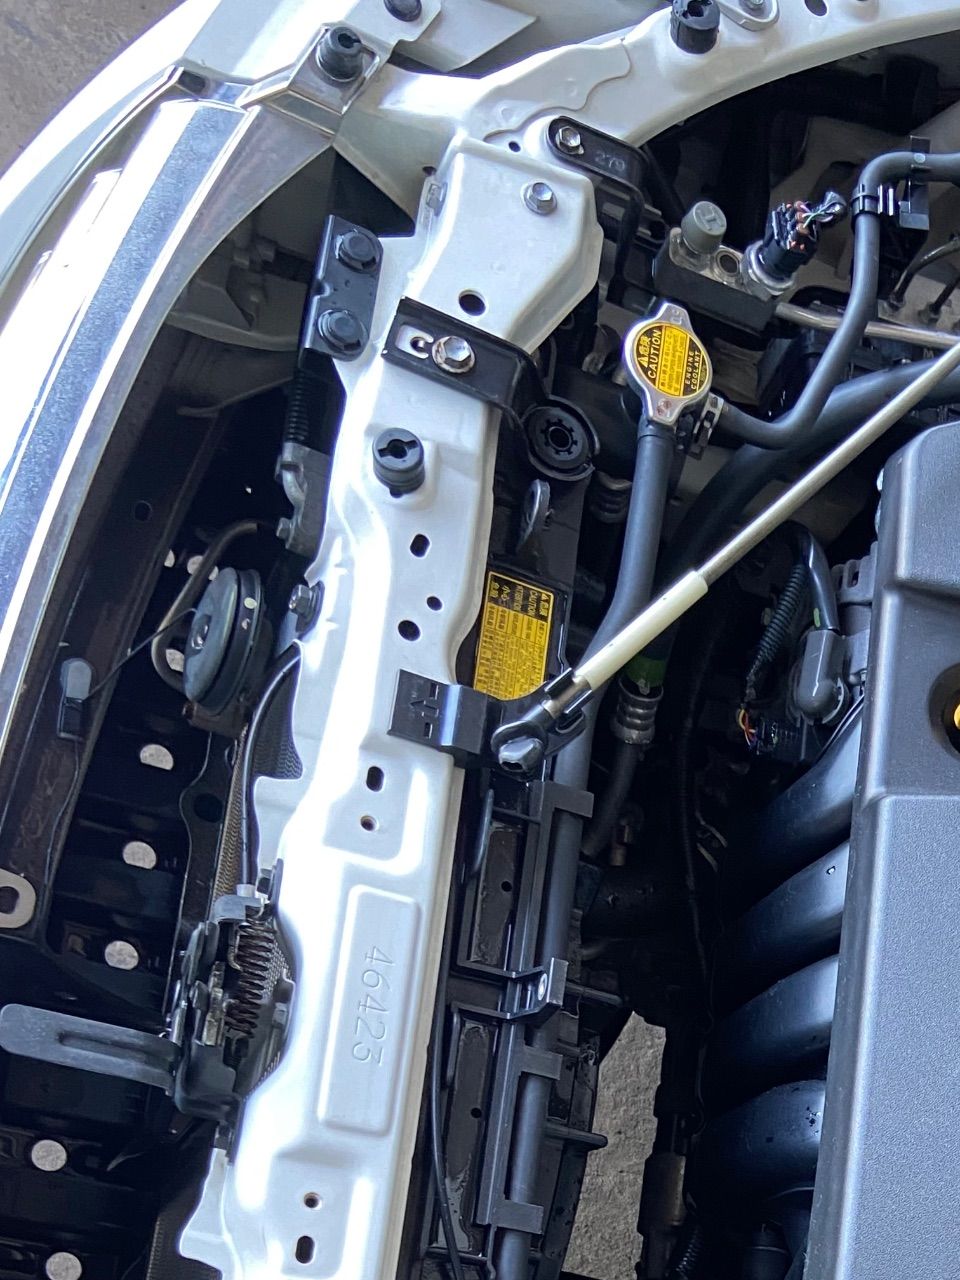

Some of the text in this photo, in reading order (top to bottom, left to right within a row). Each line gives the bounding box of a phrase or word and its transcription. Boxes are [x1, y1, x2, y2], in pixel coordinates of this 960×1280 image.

[647, 330, 662, 379] CAUTION
[684, 351, 695, 385] ENGINE
[691, 350, 702, 390] COOLANT
[527, 590, 538, 617] CAUTION
[352, 945, 396, 1067] 46423
